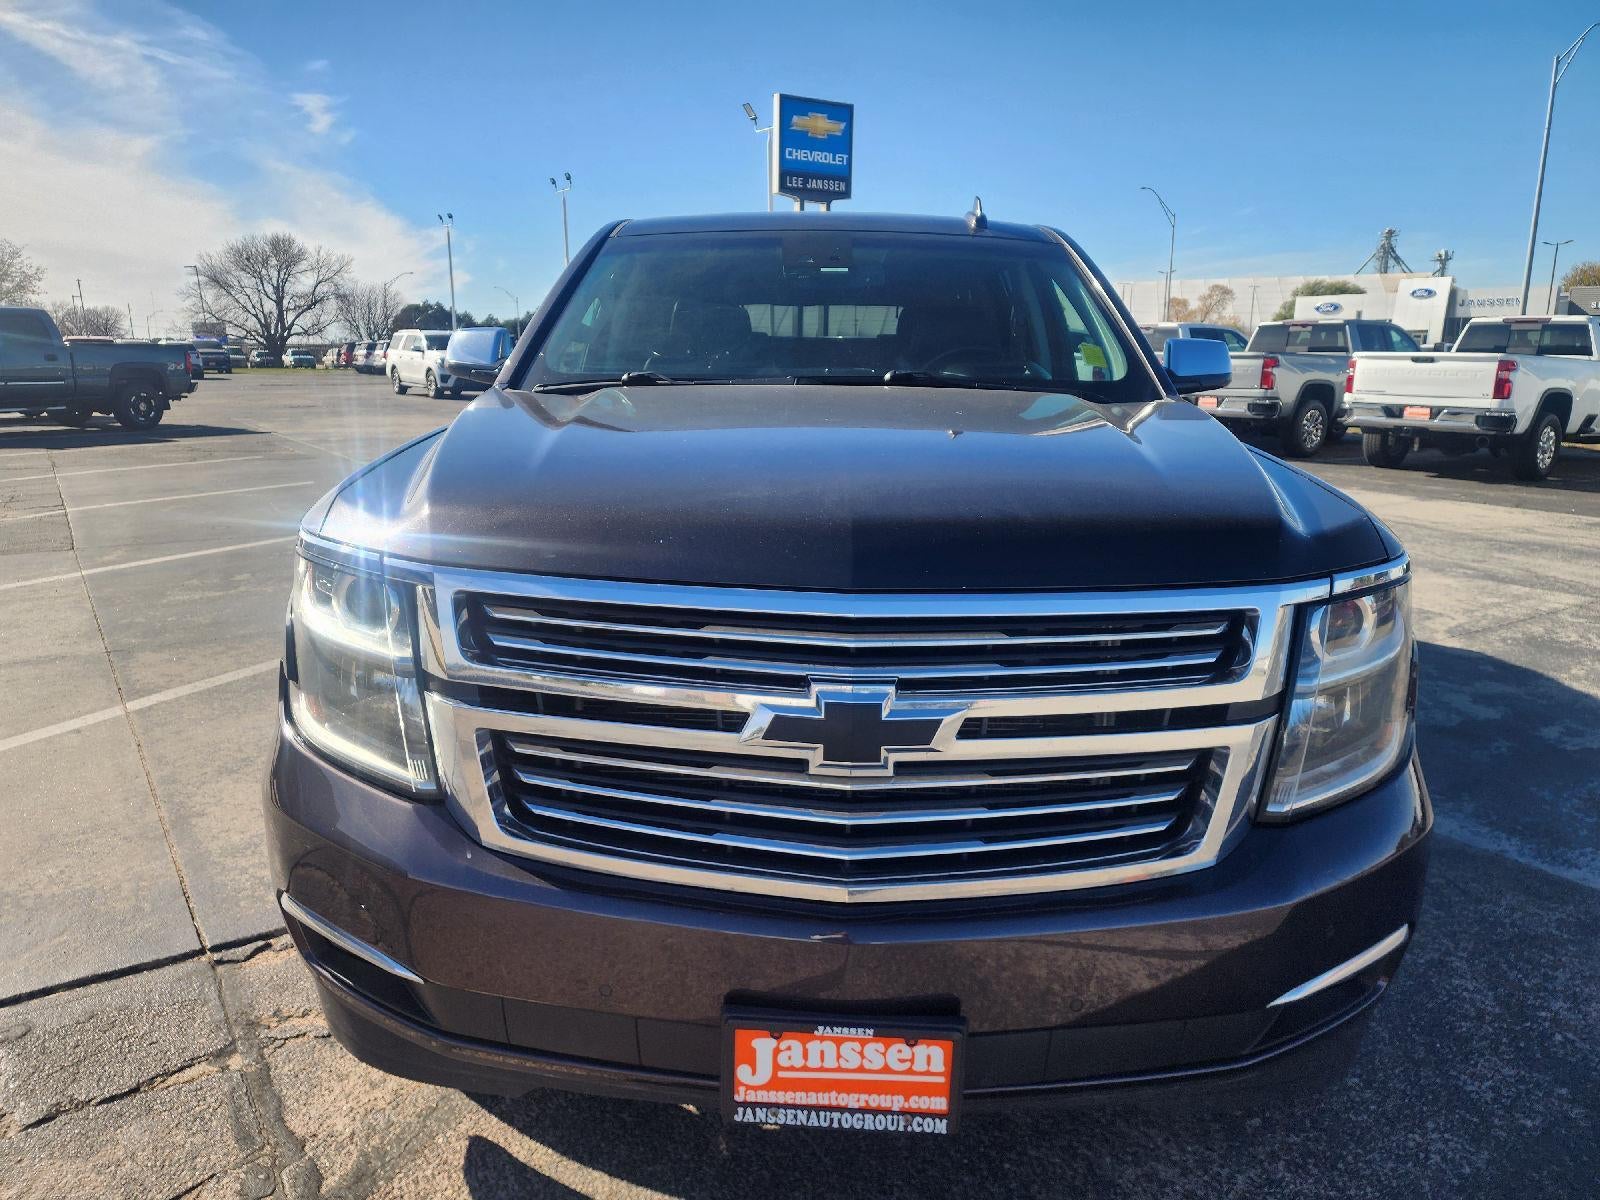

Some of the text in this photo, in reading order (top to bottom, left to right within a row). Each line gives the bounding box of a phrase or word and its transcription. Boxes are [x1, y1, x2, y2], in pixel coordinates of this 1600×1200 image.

[785, 147, 849, 166] CHEVROLET
[786, 176, 846, 192] LEE JANSSEN
[1459, 297, 1521, 307] JANSSEN
[813, 1025, 874, 1037] JANSSEN
[736, 1037, 945, 1086] Janssen
[734, 1085, 948, 1111] Janssenautogroup.com
